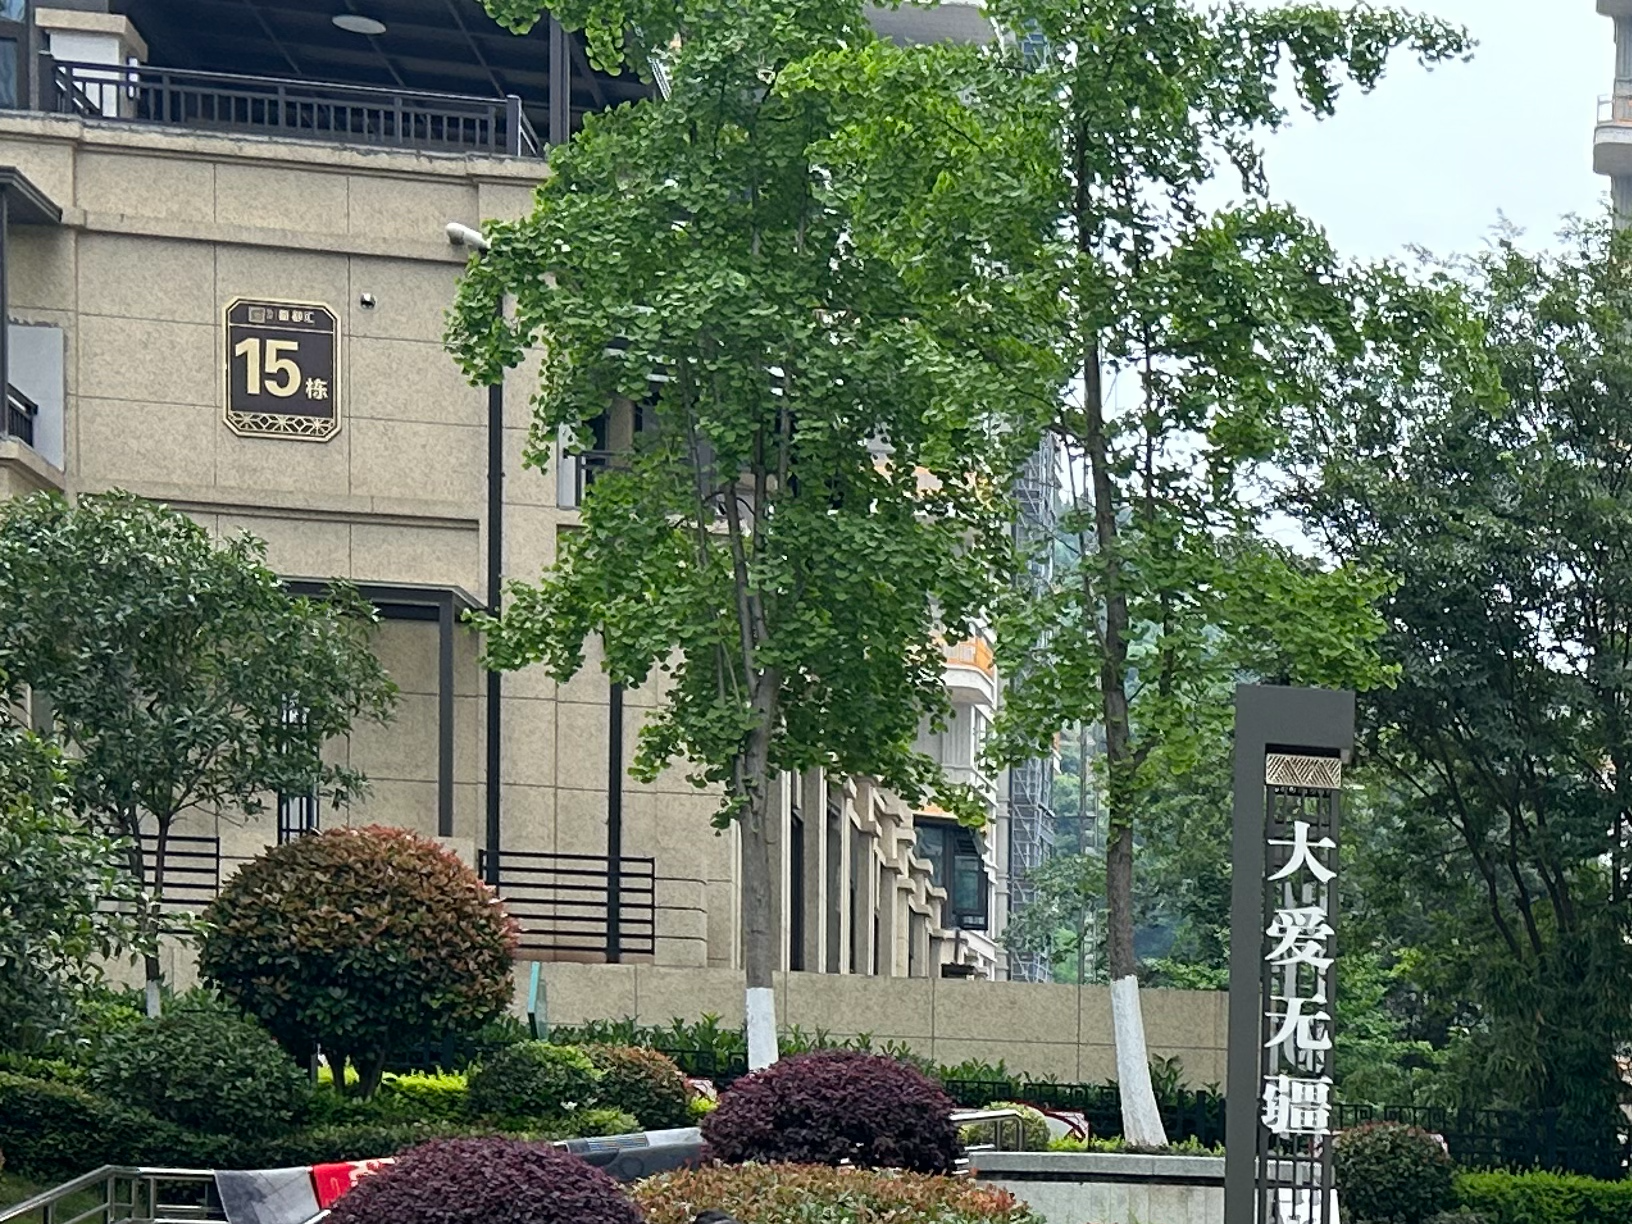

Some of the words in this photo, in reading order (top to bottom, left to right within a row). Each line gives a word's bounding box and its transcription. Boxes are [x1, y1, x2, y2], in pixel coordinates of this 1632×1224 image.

[235, 337, 329, 400] 15栋
[1260, 820, 1337, 1135] 大爱无疆
